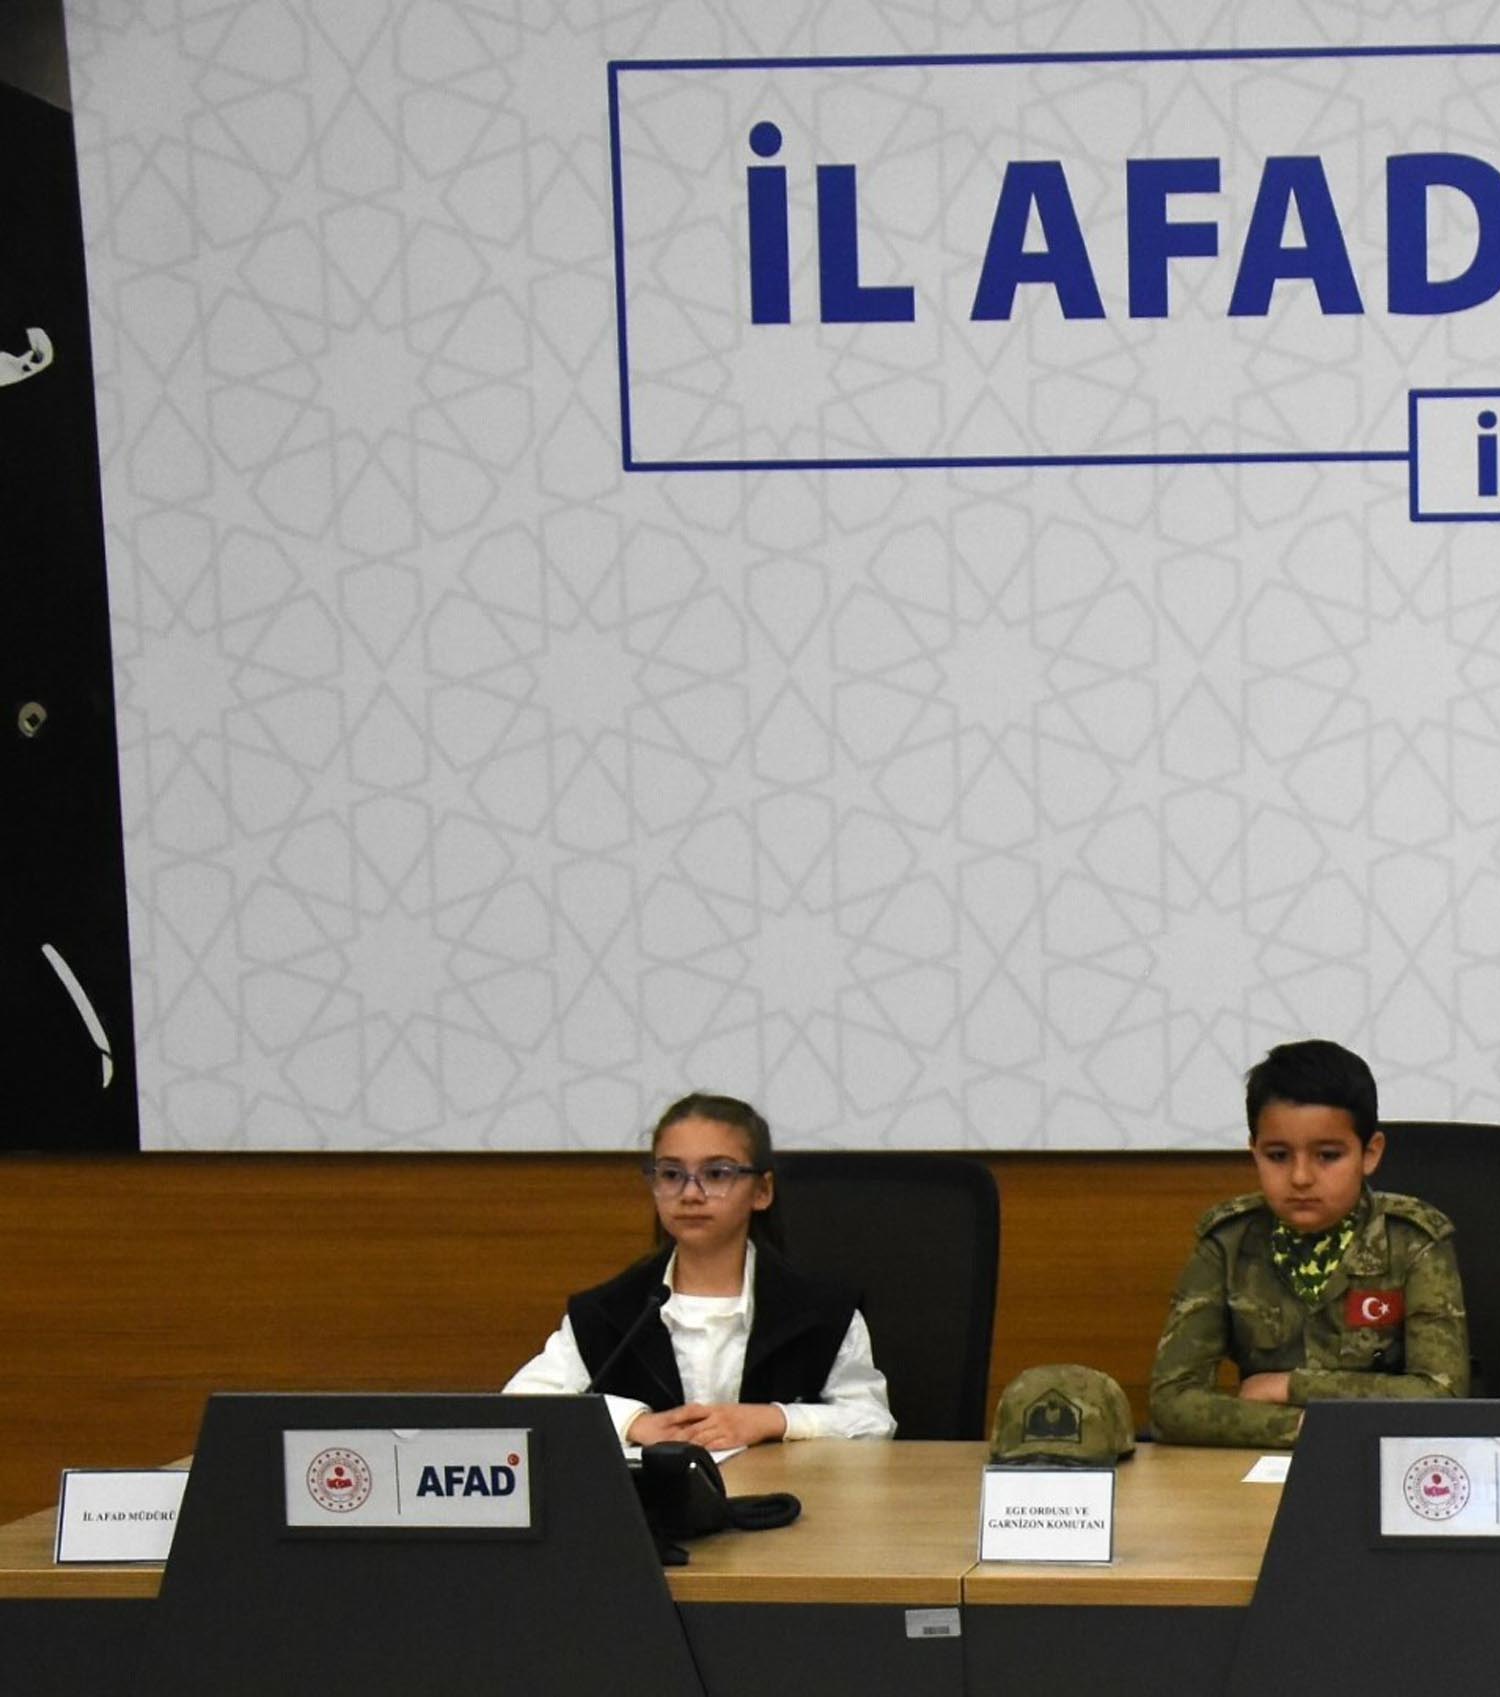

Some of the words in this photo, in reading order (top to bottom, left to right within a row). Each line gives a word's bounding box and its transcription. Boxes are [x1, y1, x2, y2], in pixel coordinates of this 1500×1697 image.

[748, 123, 916, 325] İL
[416, 1465, 516, 1498] AFAD
[83, 1510, 94, 1522] İL
[97, 1511, 126, 1522] AFAD
[129, 1510, 176, 1522] MÜDÜRÜ
[1005, 1506, 1026, 1516] EGE
[1029, 1506, 1071, 1516] ORDUSU
[1074, 1506, 1089, 1515] VE
[988, 1517, 1044, 1529] GARNİZON
[1046, 1519, 1105, 1530] KOMUTANI
